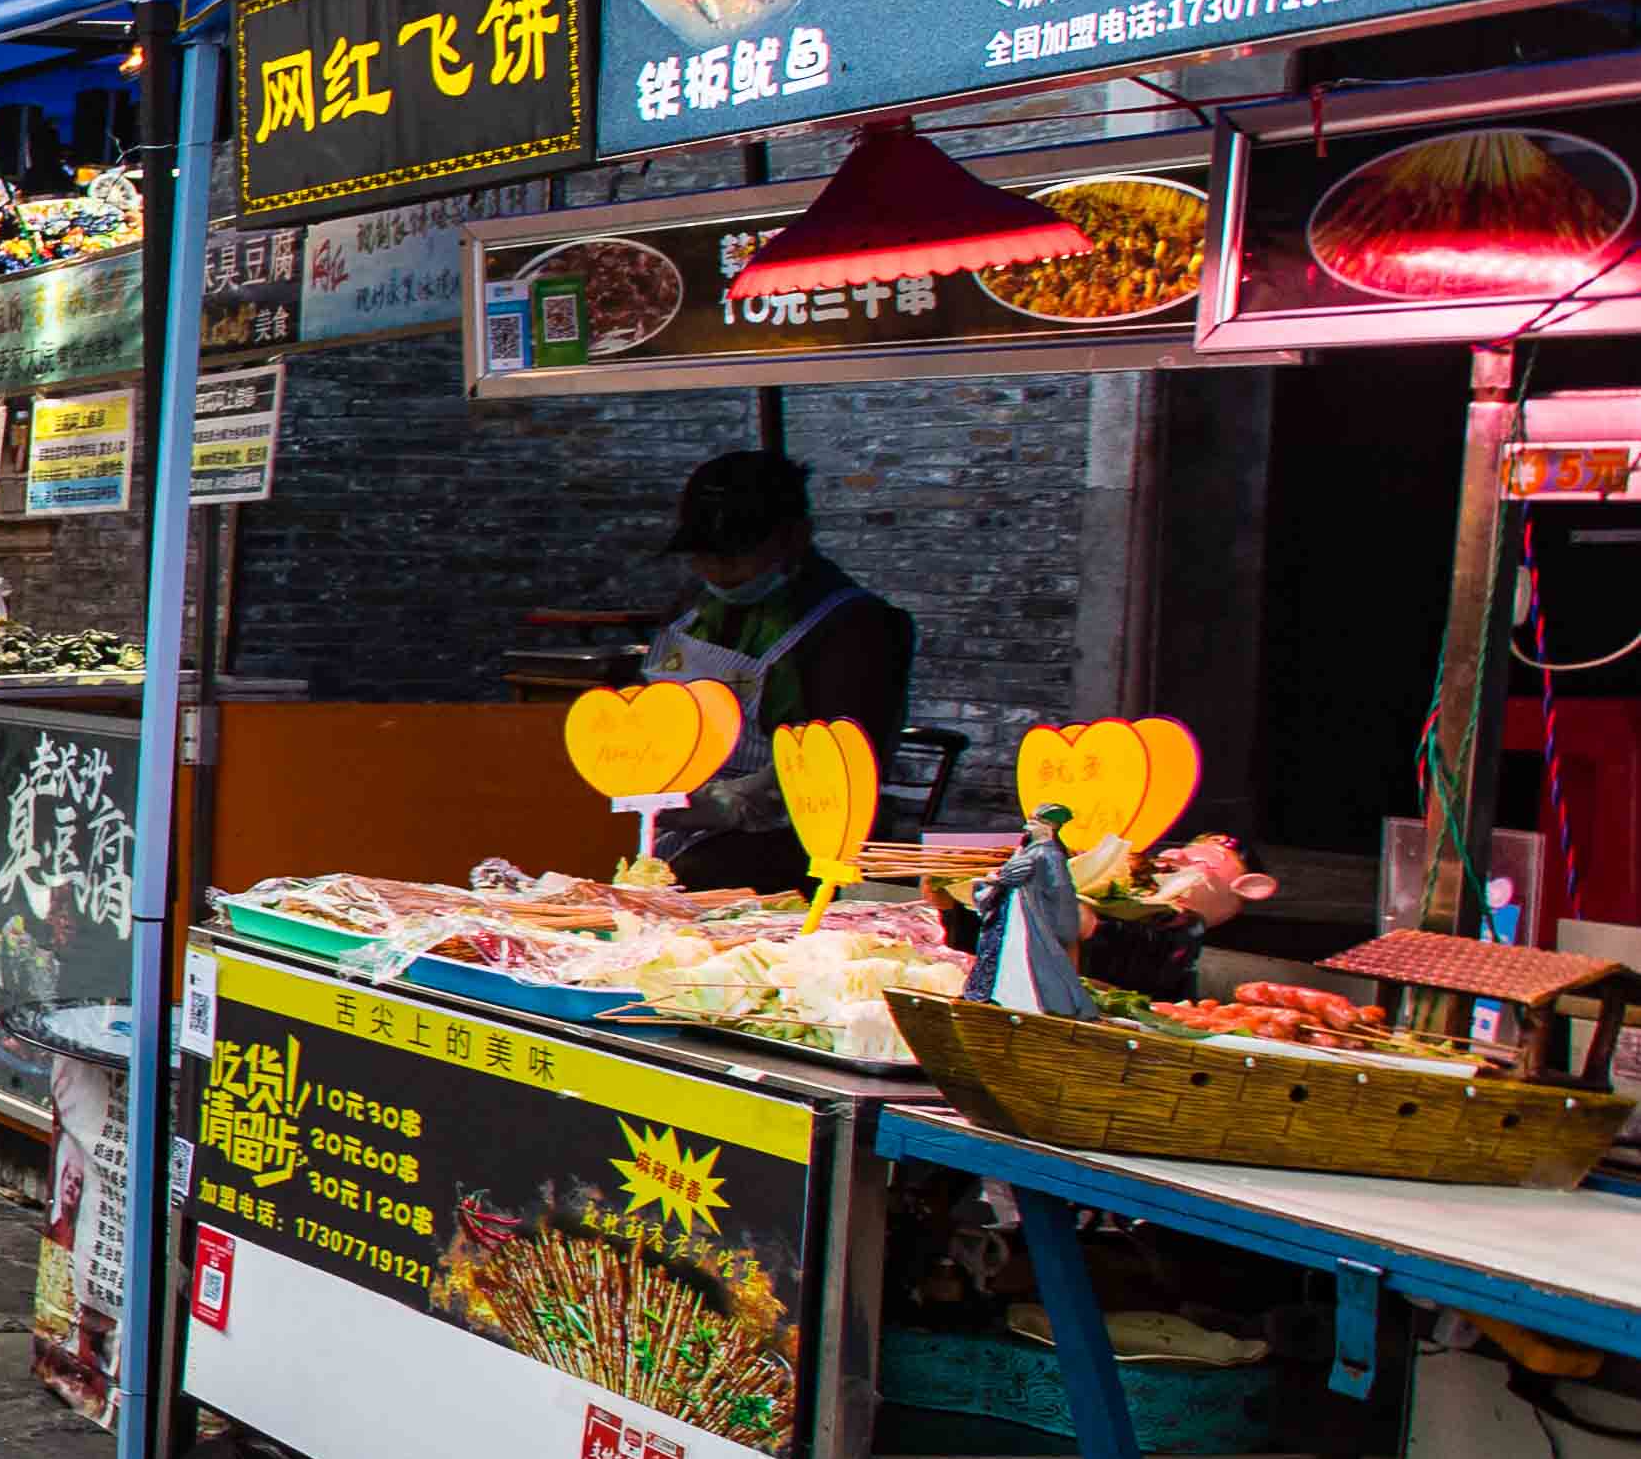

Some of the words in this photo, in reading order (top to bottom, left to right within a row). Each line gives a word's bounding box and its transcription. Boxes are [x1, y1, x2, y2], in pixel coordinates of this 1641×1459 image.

[634, 25, 831, 122] 铁板鱿鱼
[334, 993, 558, 1084] 舌尖上的美味
[316, 1083, 423, 1139] 10元30串
[310, 1126, 420, 1185] 20元60串
[306, 1168, 435, 1238] 30元120串
